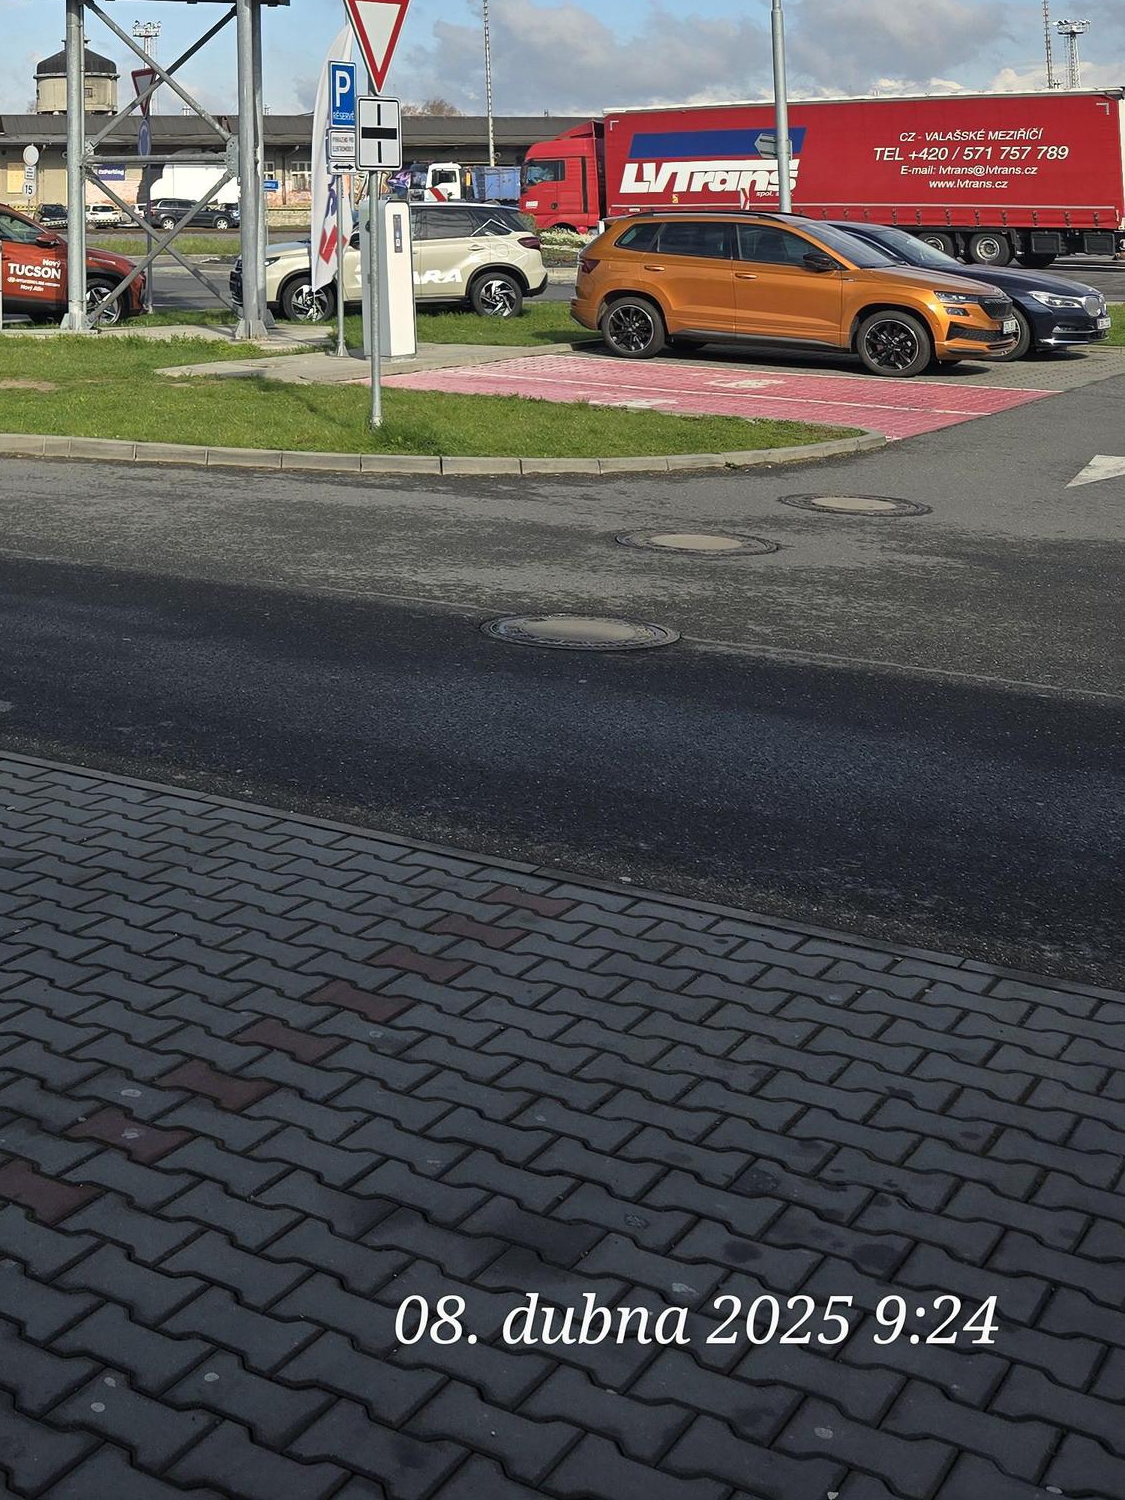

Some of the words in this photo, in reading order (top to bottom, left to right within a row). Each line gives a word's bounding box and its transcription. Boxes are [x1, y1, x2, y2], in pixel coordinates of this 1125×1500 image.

[899, 132, 916, 142] CZ
[925, 129, 985, 141] VALAŠSKÉ
[987, 127, 1044, 141] MEZIŘÍČÍ
[874, 147, 904, 161] TEL
[908, 147, 949, 161] +420
[962, 146, 993, 160] 571
[999, 146, 1032, 160] 757
[1036, 145, 1069, 160] 789
[900, 165, 937, 175] E-mail:
[938, 165, 1038, 176] lvtrans@lvtrans.cz
[25, 184, 33, 195] 15
[928, 179, 1008, 189] www.lvtrans.cz
[42, 259, 61, 267] Nový
[8, 262, 61, 280] TUCSON
